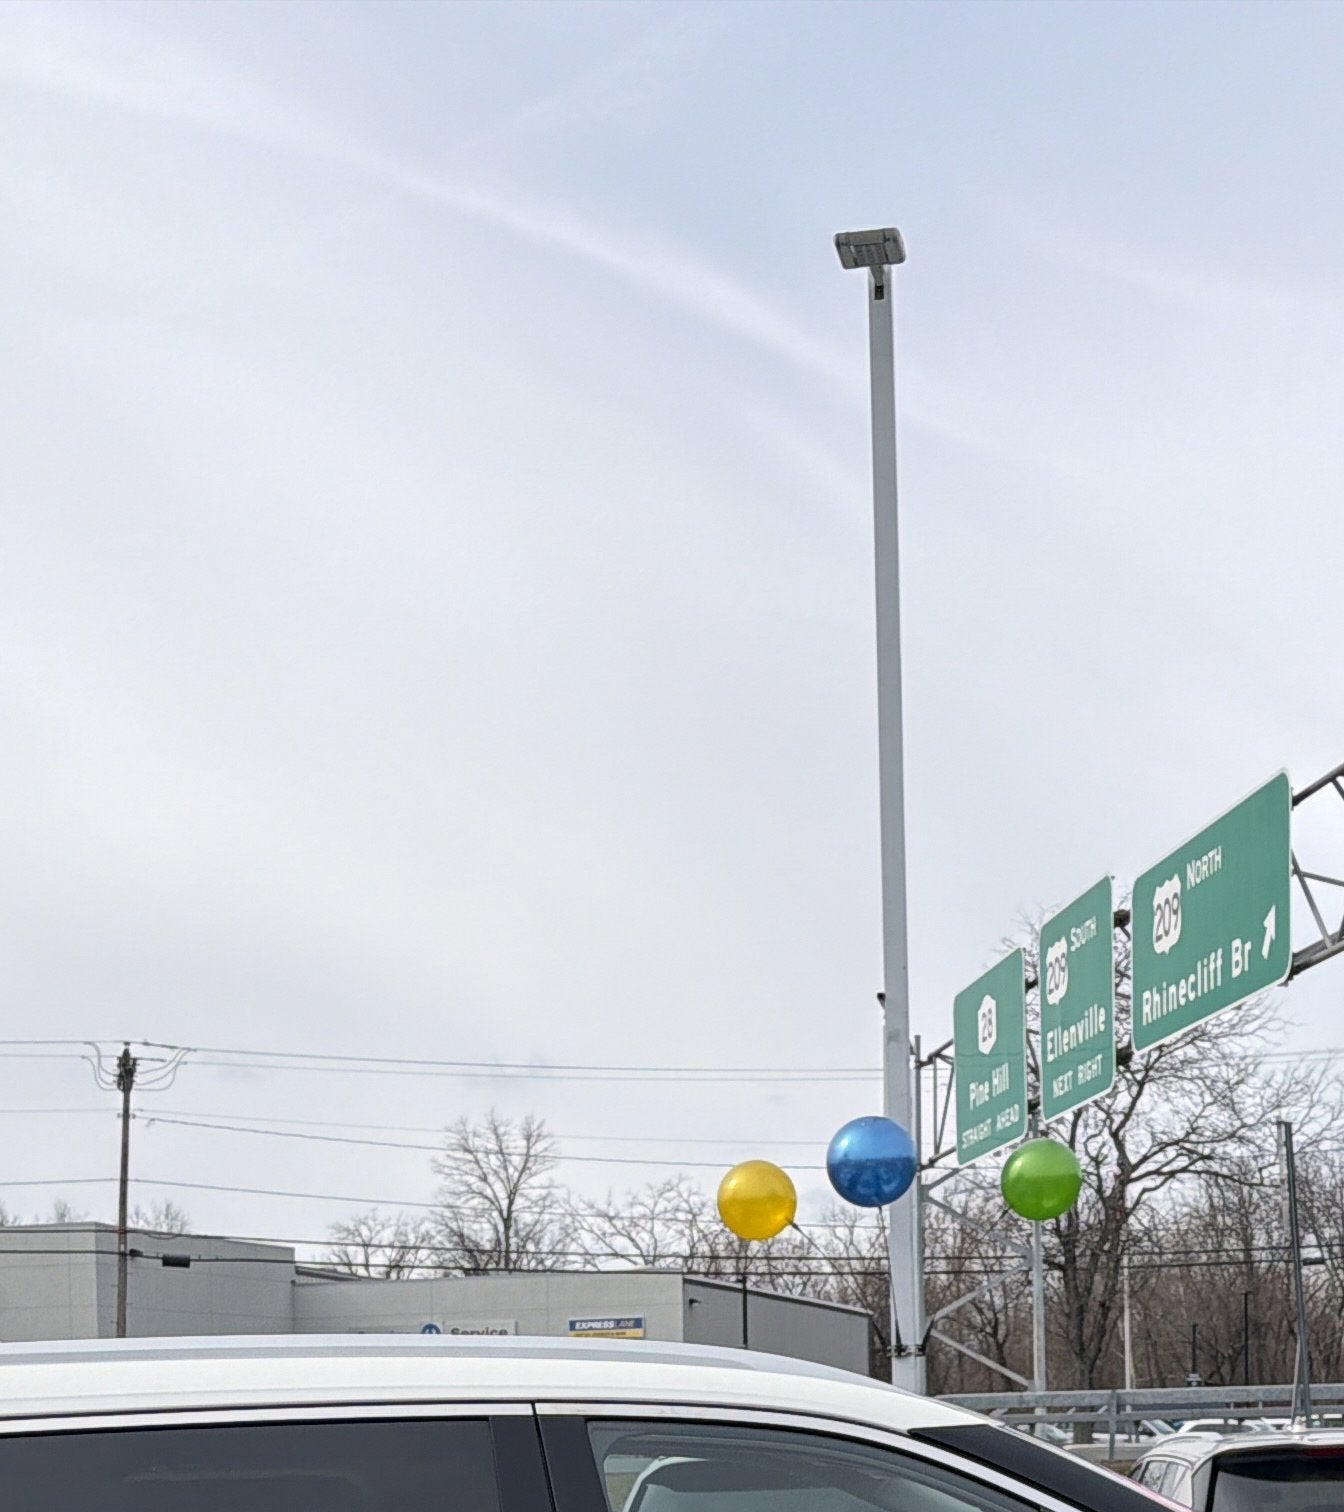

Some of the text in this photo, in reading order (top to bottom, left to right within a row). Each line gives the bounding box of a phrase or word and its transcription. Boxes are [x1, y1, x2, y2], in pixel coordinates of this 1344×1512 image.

[1186, 846, 1222, 890] NORTH
[1070, 915, 1097, 951] SOUTH
[1155, 892, 1180, 943] 209
[1048, 952, 1066, 995] 209
[1142, 938, 1252, 1026] Rhinecliff Br
[981, 1008, 993, 1043] 28
[1047, 1003, 1106, 1063] Ellenville
[969, 1062, 1009, 1112] Pine Hill
[1052, 1053, 1102, 1099] NEXT RIGHT
